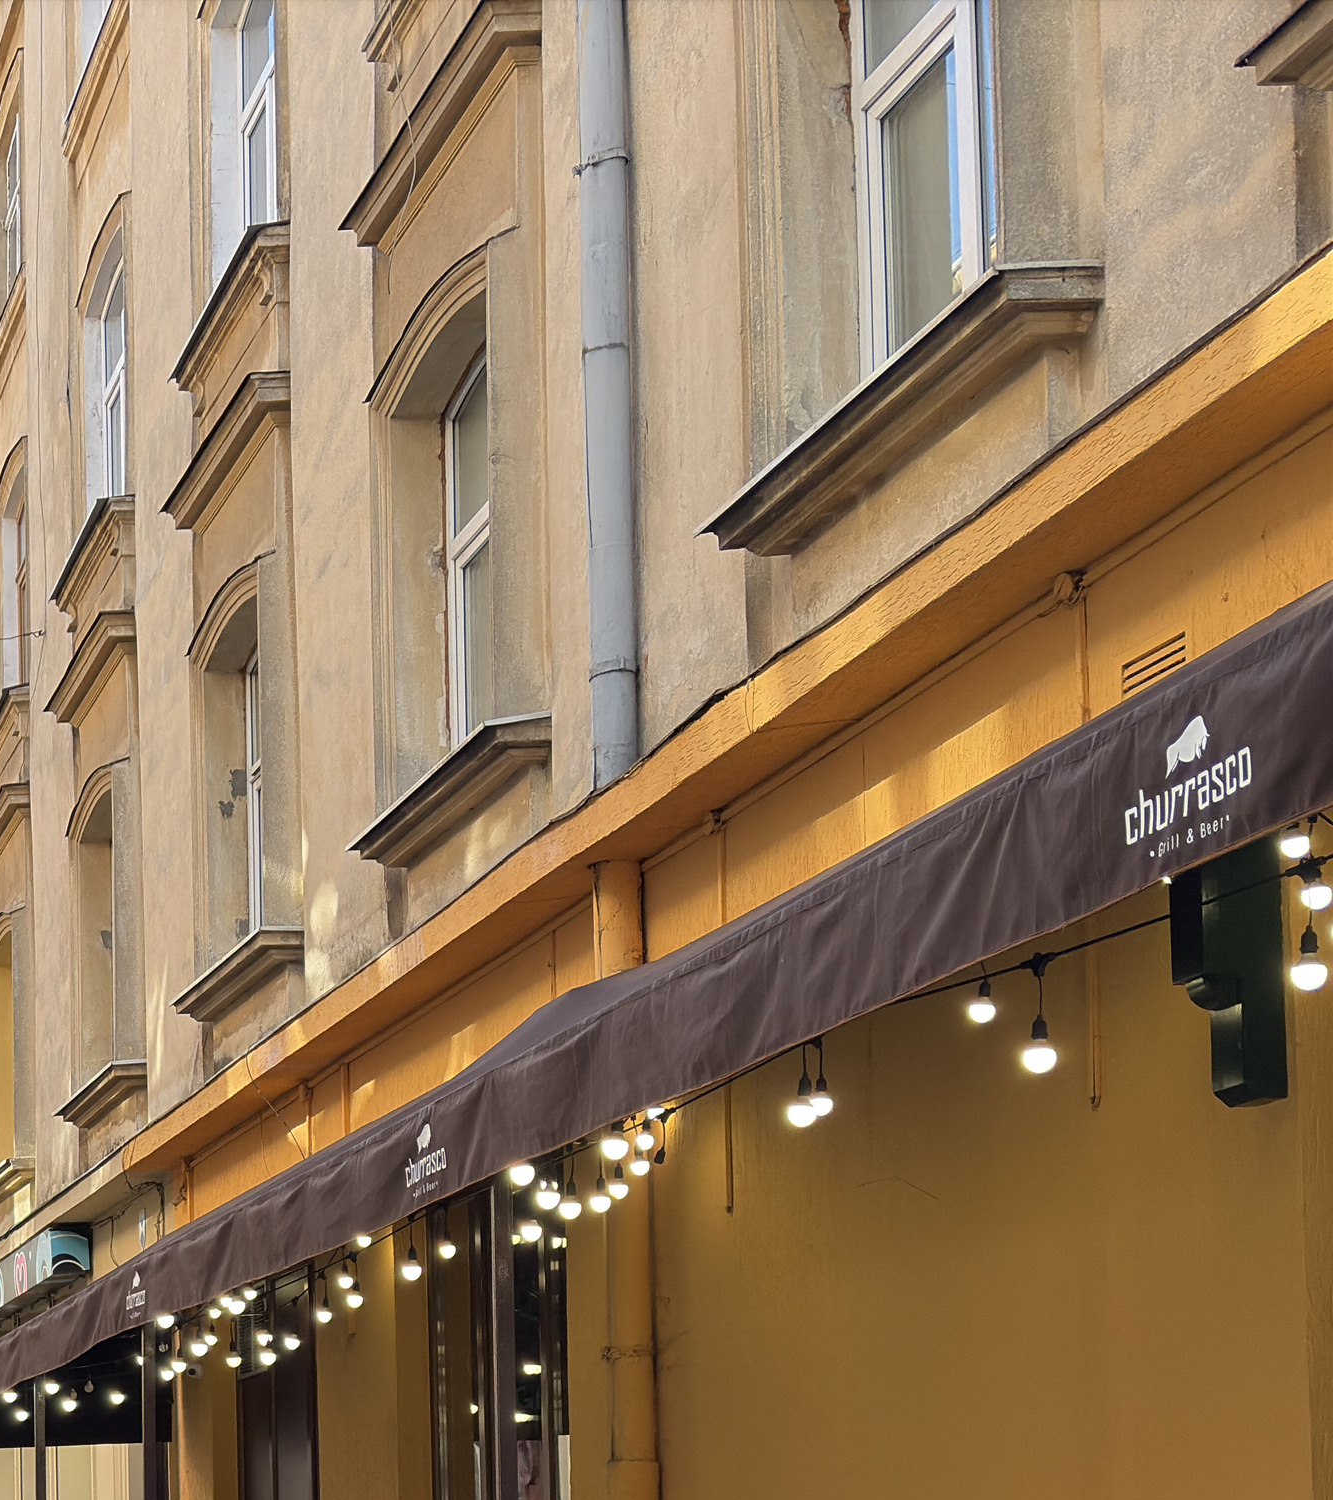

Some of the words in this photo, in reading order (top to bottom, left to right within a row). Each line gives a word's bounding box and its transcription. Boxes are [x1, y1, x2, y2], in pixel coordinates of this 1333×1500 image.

[1124, 746, 1252, 846] churrasco
[1157, 832, 1180, 858] Grill
[1186, 827, 1194, 844] &
[1200, 818, 1224, 839] Beer
[405, 1147, 447, 1188] churrasco
